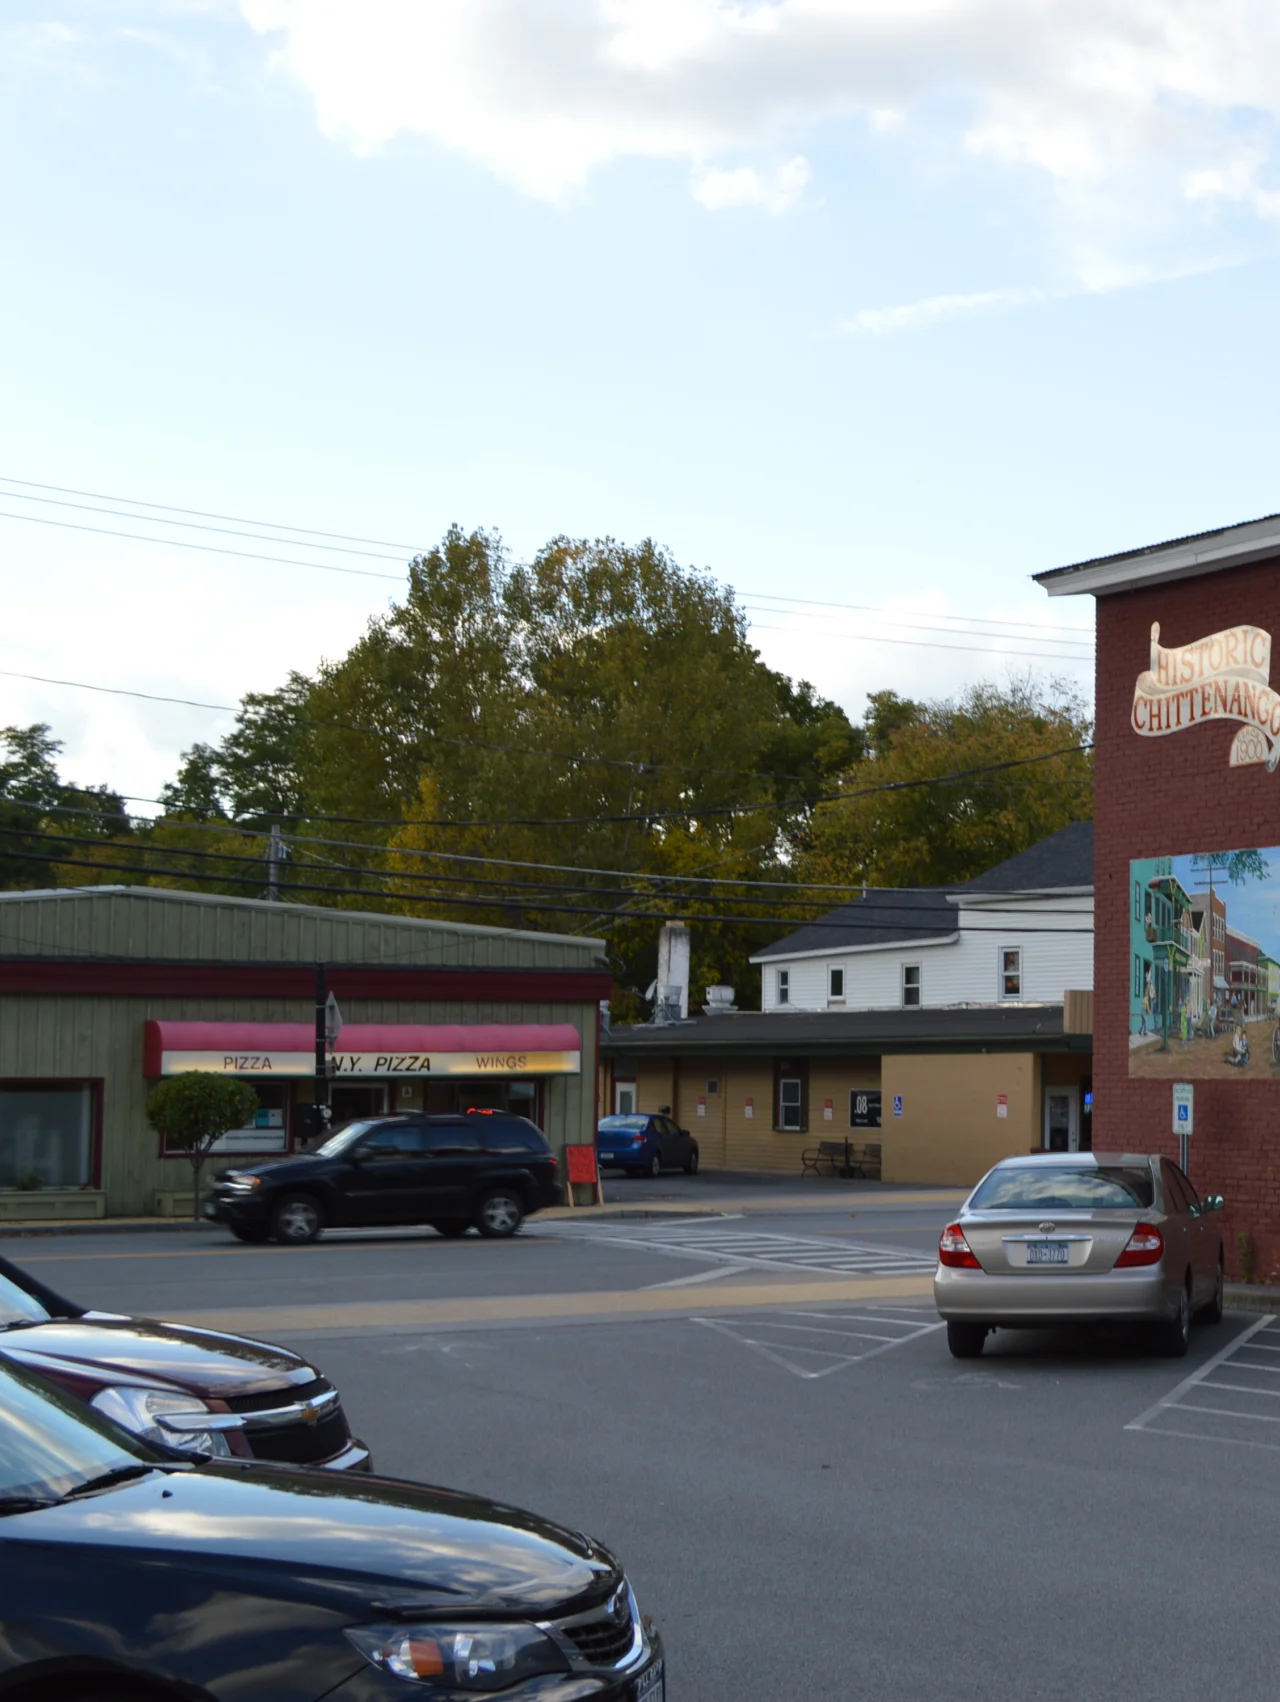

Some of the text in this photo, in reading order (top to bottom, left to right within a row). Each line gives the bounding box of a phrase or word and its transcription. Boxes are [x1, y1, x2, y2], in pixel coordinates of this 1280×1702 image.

[1156, 629, 1267, 687] HISTORIC
[1235, 739, 1263, 763] 1900
[223, 1055, 273, 1071] PIZZA
[373, 1055, 431, 1073] PIZZA
[475, 1055, 528, 1070] WINGS
